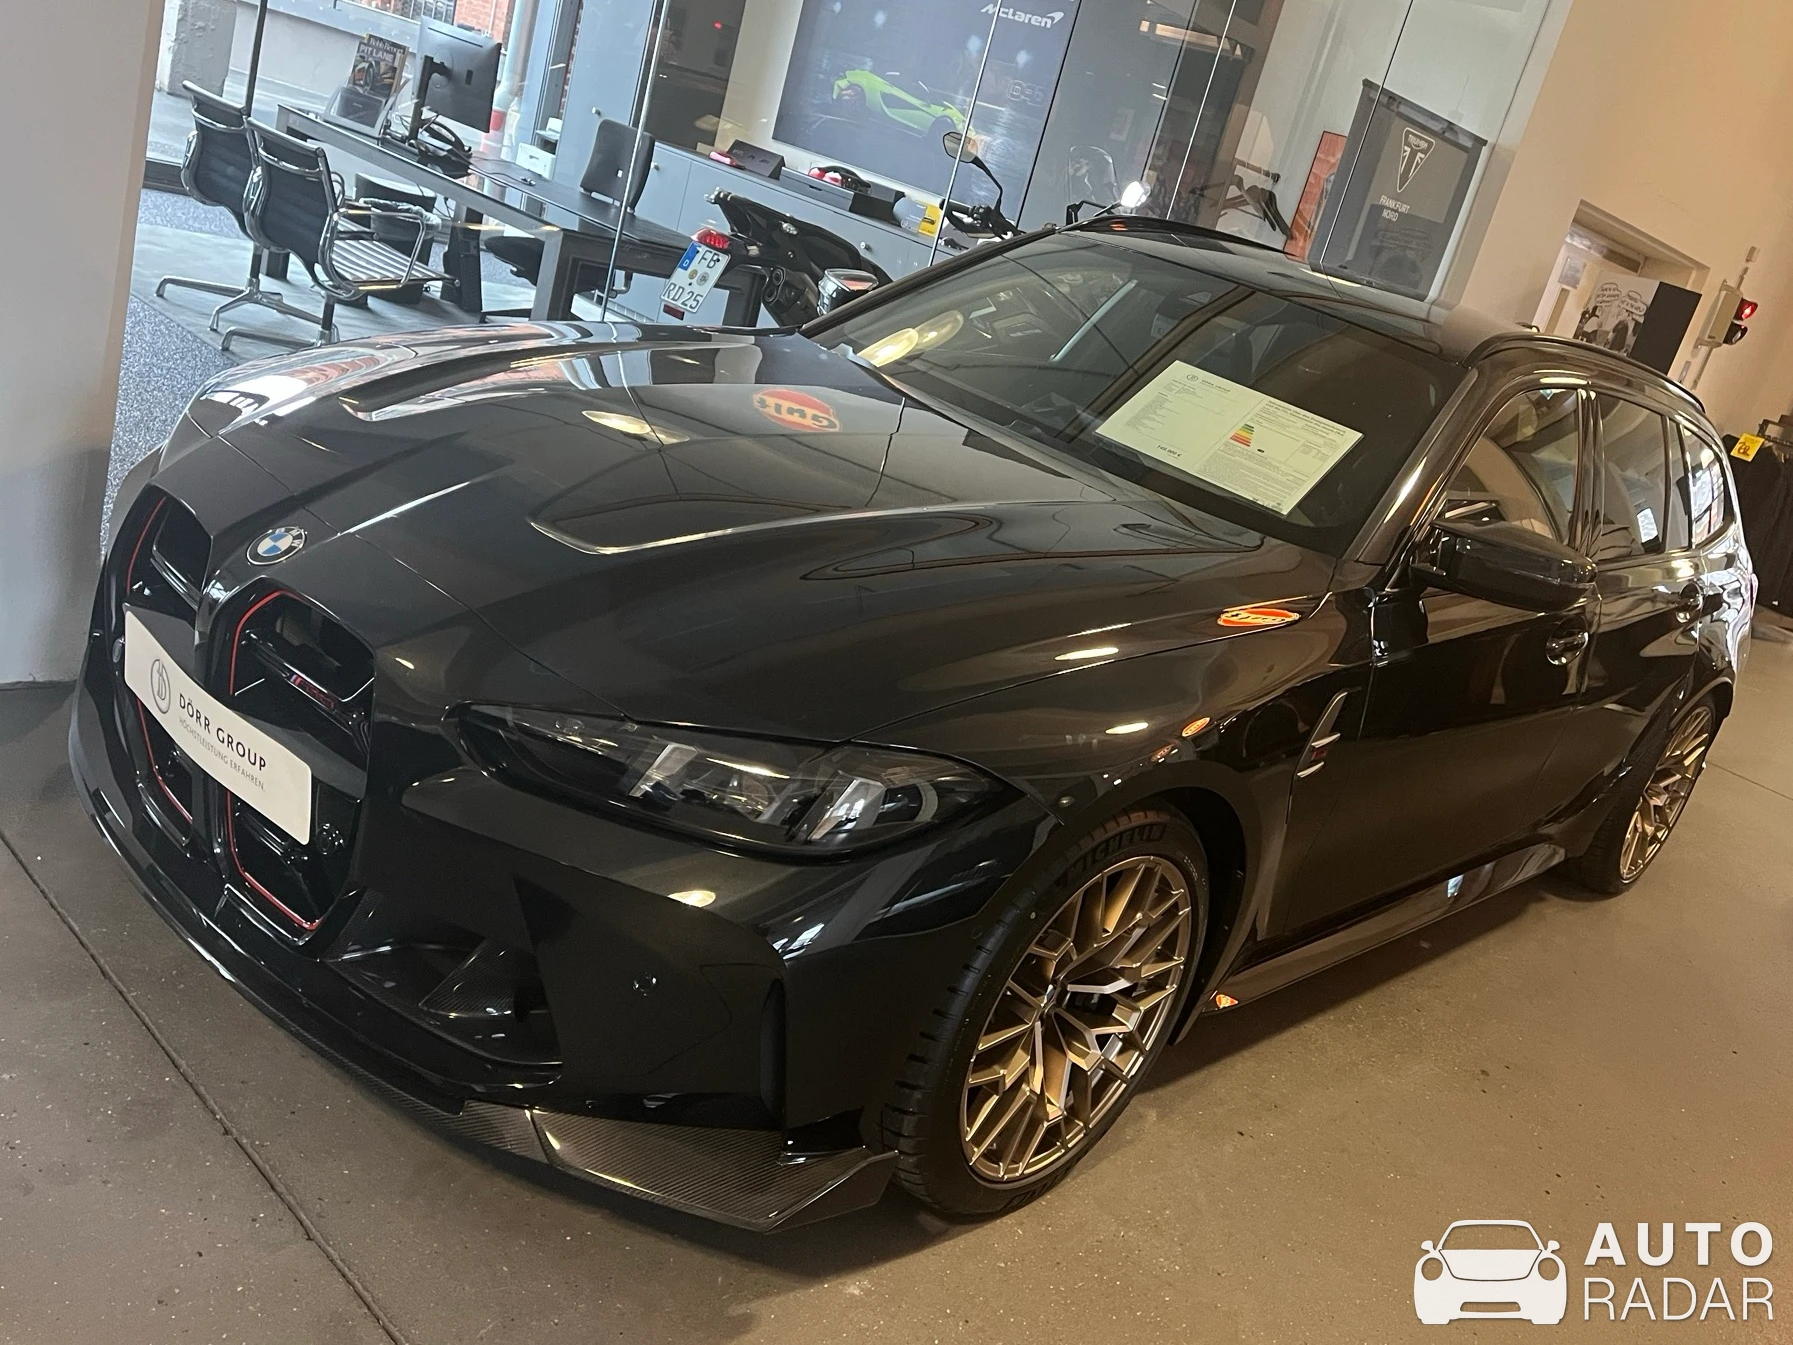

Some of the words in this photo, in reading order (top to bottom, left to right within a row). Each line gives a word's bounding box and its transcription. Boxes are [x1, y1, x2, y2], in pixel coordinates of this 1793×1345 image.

[980, 3, 1052, 28] McLaren
[360, 44, 373, 56] PIT
[373, 49, 395, 62] LANE
[1408, 134, 1428, 149] TRIUMPH
[1380, 195, 1410, 213] FRANKFURT
[1382, 208, 1399, 221] NORD
[698, 249, 720, 269] FB
[663, 282, 685, 302] RD
[680, 291, 704, 310] 25
[179, 693, 211, 734] DÖRR
[216, 727, 266, 771] GROUP
[180, 716, 229, 765] HÖCHSTLEISTUNG
[229, 760, 266, 792] ERFAHREN.
[1060, 824, 1167, 888] MICHELIN
